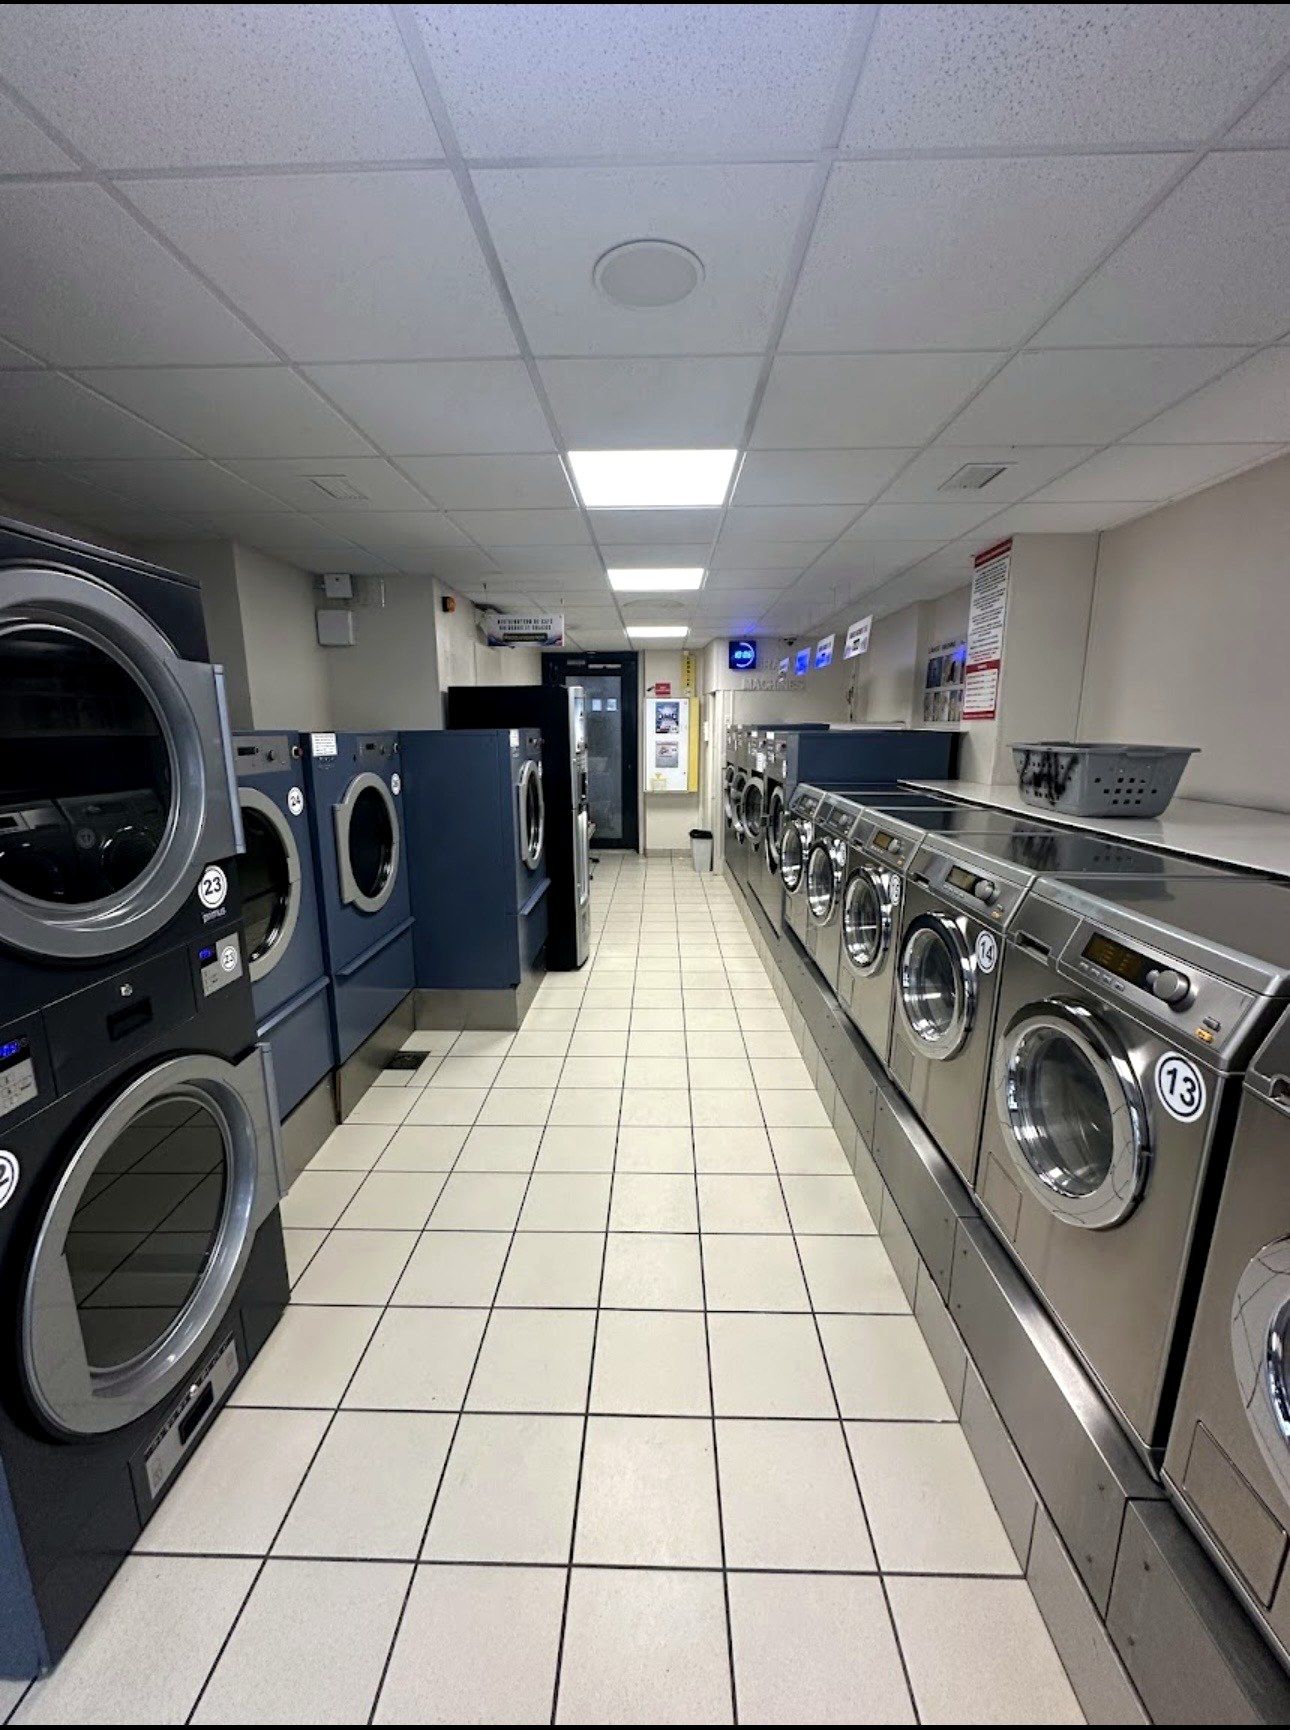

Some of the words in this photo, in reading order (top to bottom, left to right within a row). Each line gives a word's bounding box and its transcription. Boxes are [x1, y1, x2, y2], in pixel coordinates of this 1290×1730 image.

[204, 877, 222, 895] 23
[980, 941, 993, 962] 14
[1166, 1067, 1196, 1107] 13
